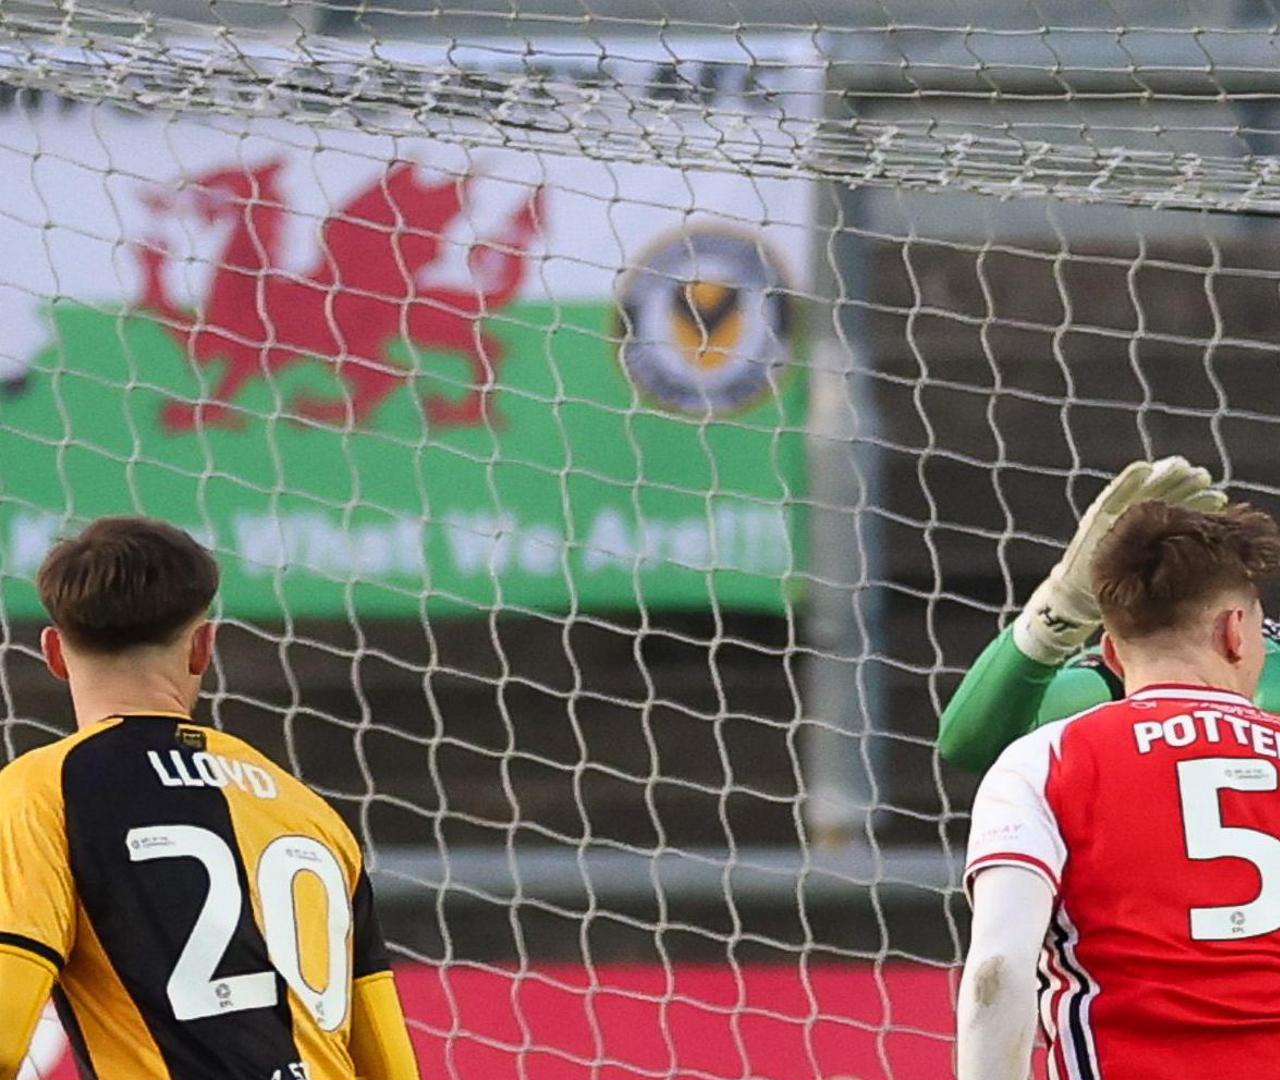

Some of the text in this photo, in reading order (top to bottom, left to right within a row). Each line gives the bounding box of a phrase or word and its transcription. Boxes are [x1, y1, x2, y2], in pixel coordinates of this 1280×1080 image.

[234, 511, 425, 576] What
[441, 509, 563, 576] We
[147, 750, 278, 799] LLOYD
[125, 824, 352, 1033] 20
